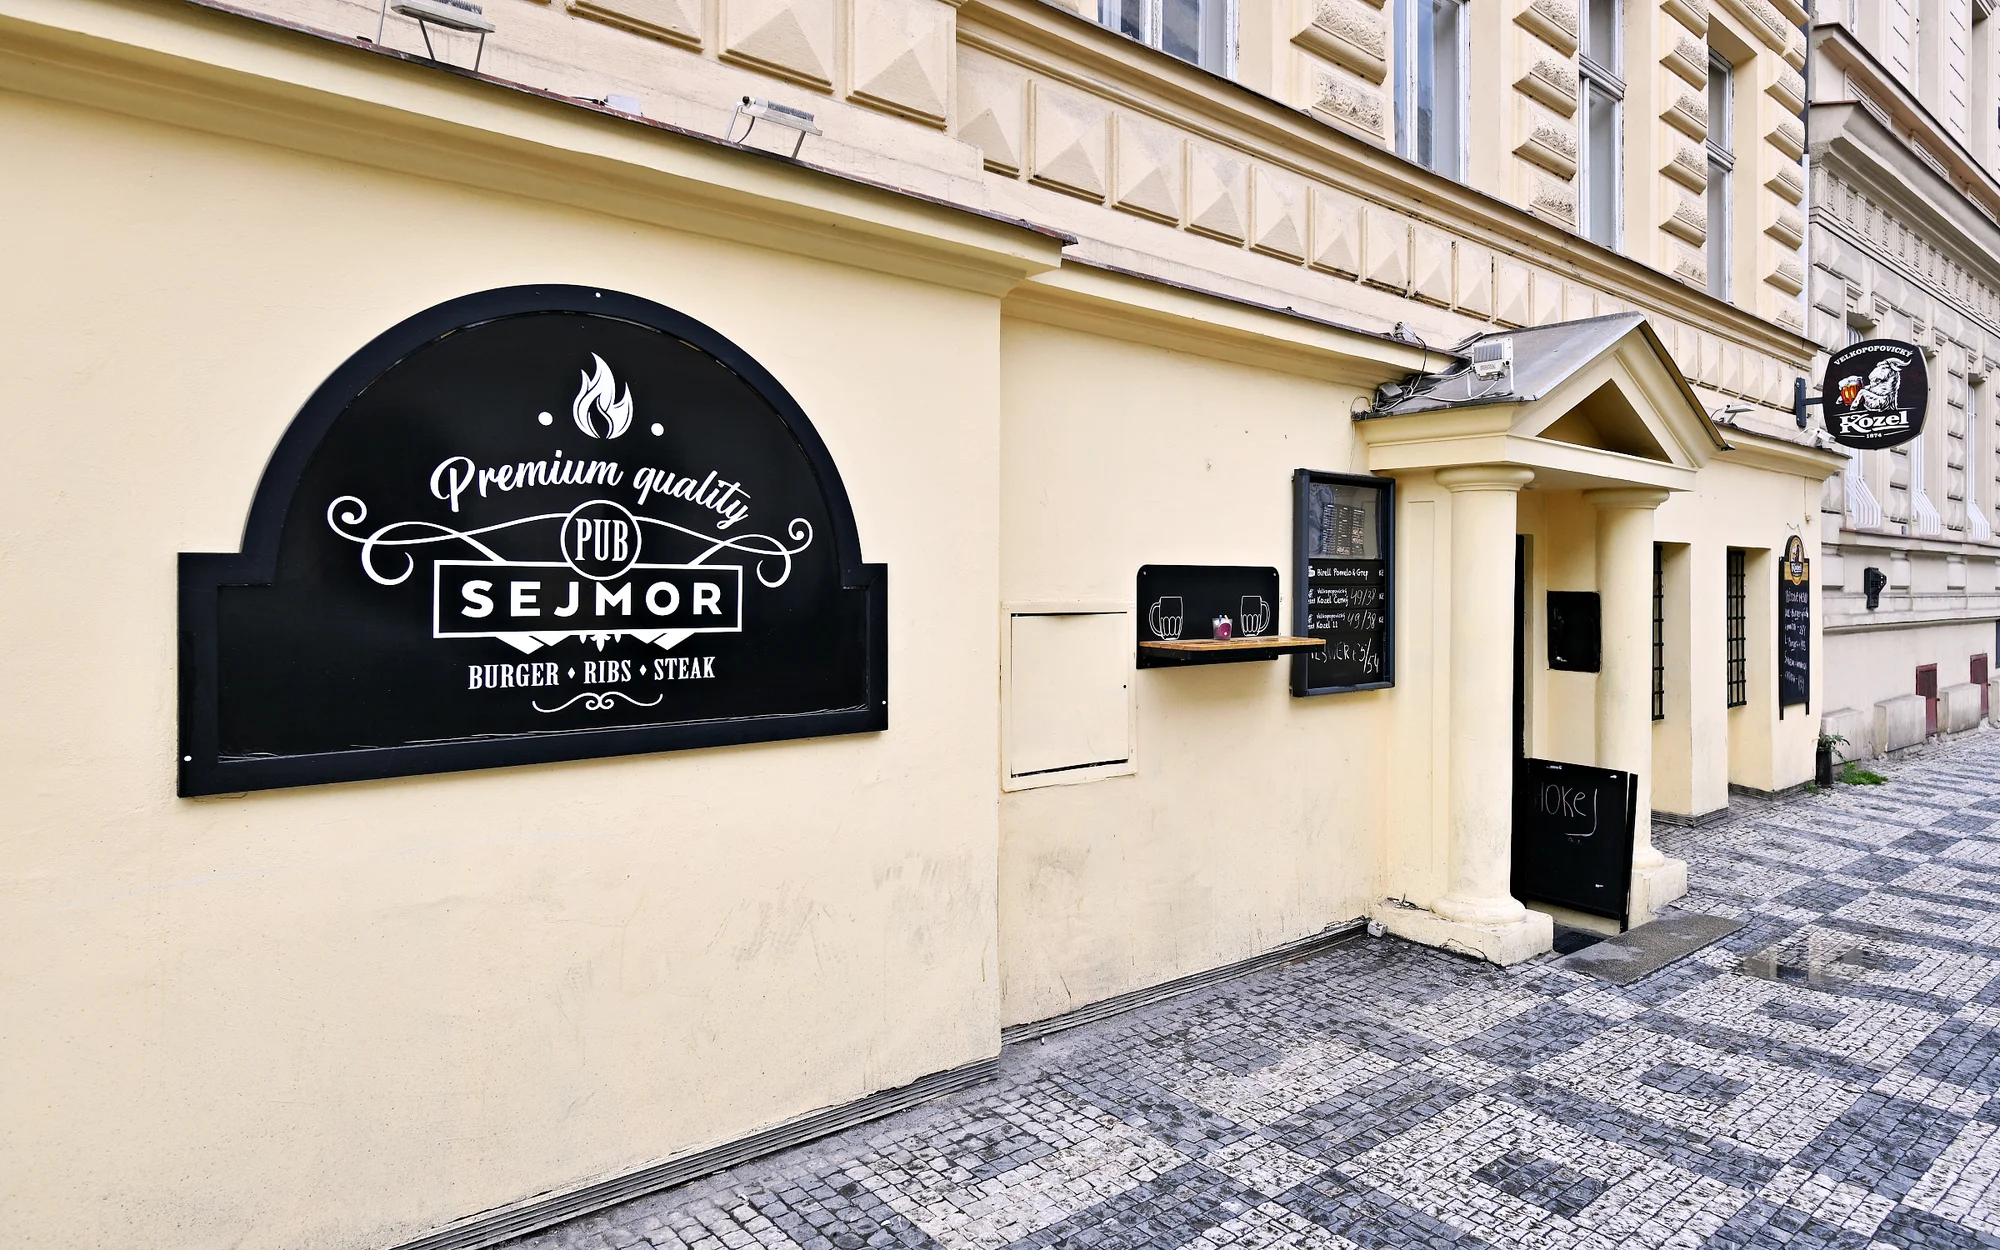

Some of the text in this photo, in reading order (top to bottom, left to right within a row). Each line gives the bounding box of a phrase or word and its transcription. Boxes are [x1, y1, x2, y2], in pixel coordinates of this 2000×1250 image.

[1834, 345, 1913, 366] VELKOPOPOVICKÝ
[1839, 410, 1909, 434] Kozel
[430, 450, 752, 530] Premium quality
[575, 518, 629, 562] PUB
[1316, 568, 1332, 577] Birell
[461, 579, 723, 619] SEJMOR
[1316, 595, 1332, 604] Kozel
[1316, 620, 1331, 629] Kozel
[468, 656, 716, 690] BURGER RIBS STEAK
